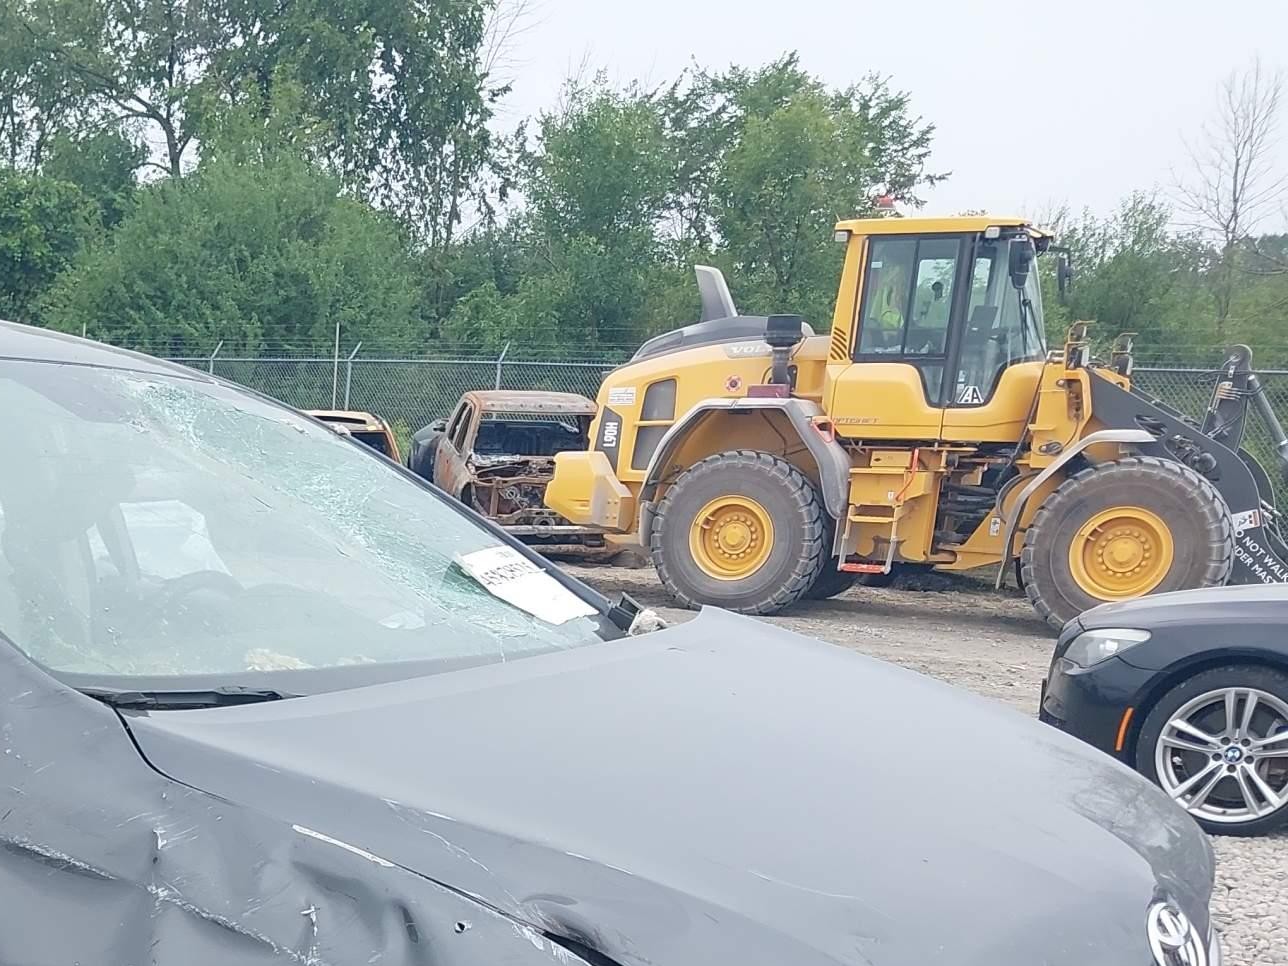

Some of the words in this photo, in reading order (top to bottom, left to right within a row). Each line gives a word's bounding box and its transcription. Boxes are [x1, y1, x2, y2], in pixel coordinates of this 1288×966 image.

[602, 421, 619, 448] L90H
[1235, 545, 1254, 566] DER
[1242, 536, 1266, 557] NOT
[1263, 554, 1288, 582] WALK
